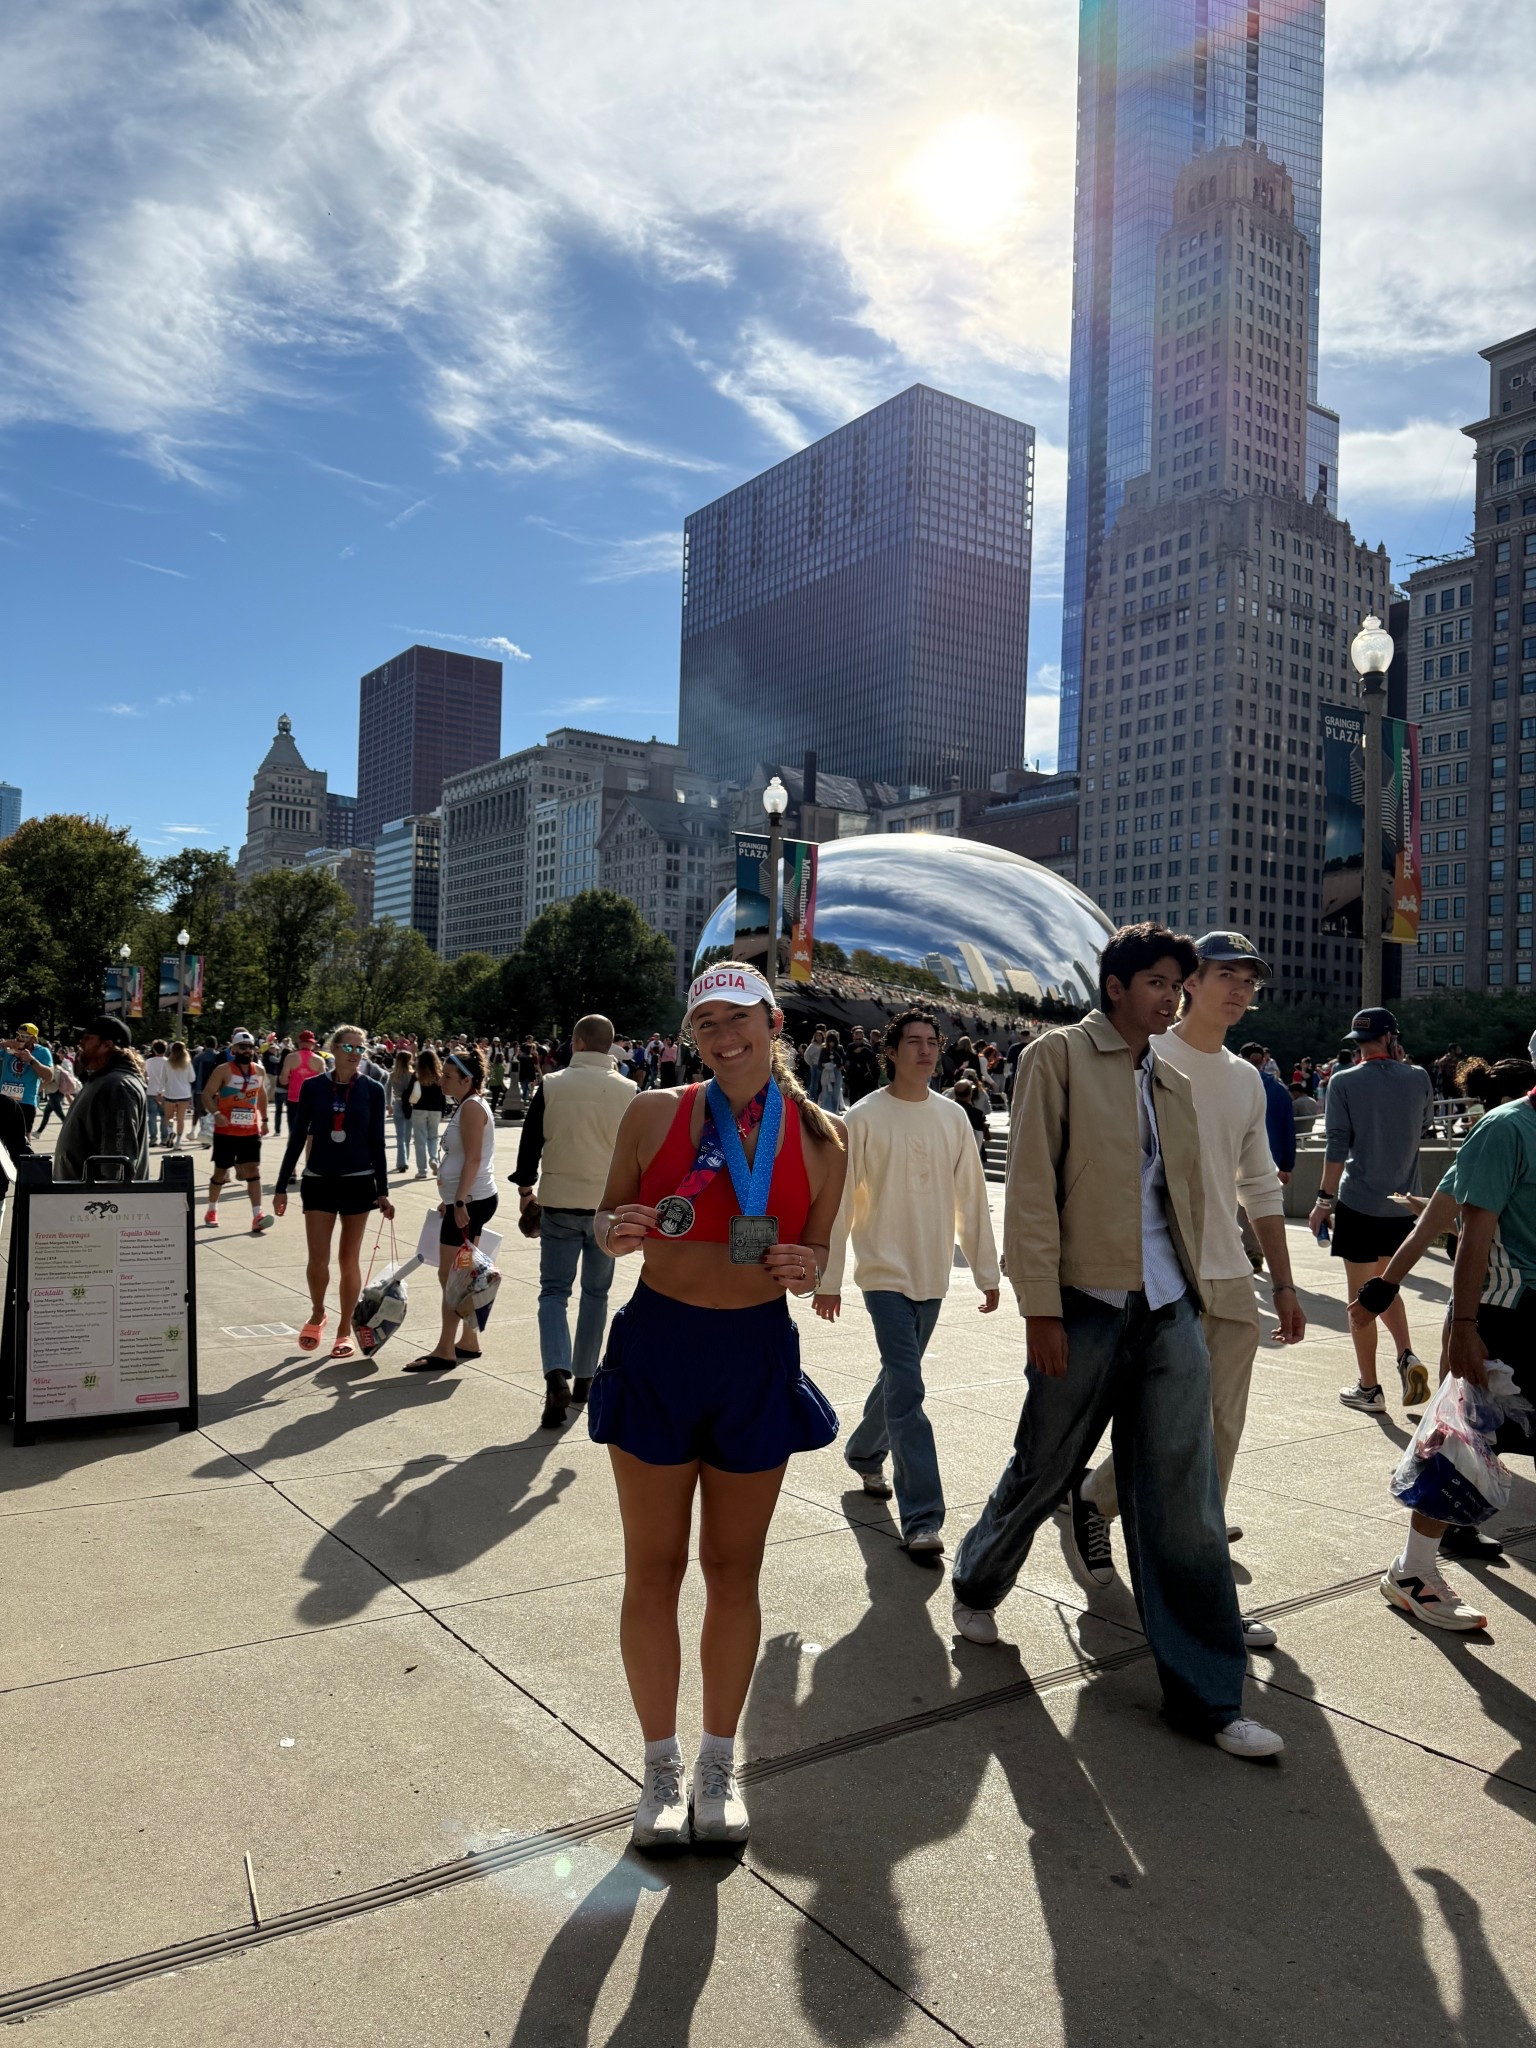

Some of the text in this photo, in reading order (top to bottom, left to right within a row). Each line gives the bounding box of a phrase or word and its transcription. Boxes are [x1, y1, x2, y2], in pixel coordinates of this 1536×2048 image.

[1324, 715, 1360, 731] GRAINGER
[1325, 726, 1360, 745] PLAZA
[738, 841, 768, 851] GRAINGER
[738, 848, 768, 860] PLAZA
[70, 1213, 151, 1222] CASA BONITA
[58, 1231, 90, 1240] Beverages
[120, 1230, 143, 1238] Tequila
[33, 1287, 85, 1297] Cocktails $14
[168, 1329, 179, 1338] $9
[83, 1375, 97, 1384] $11
